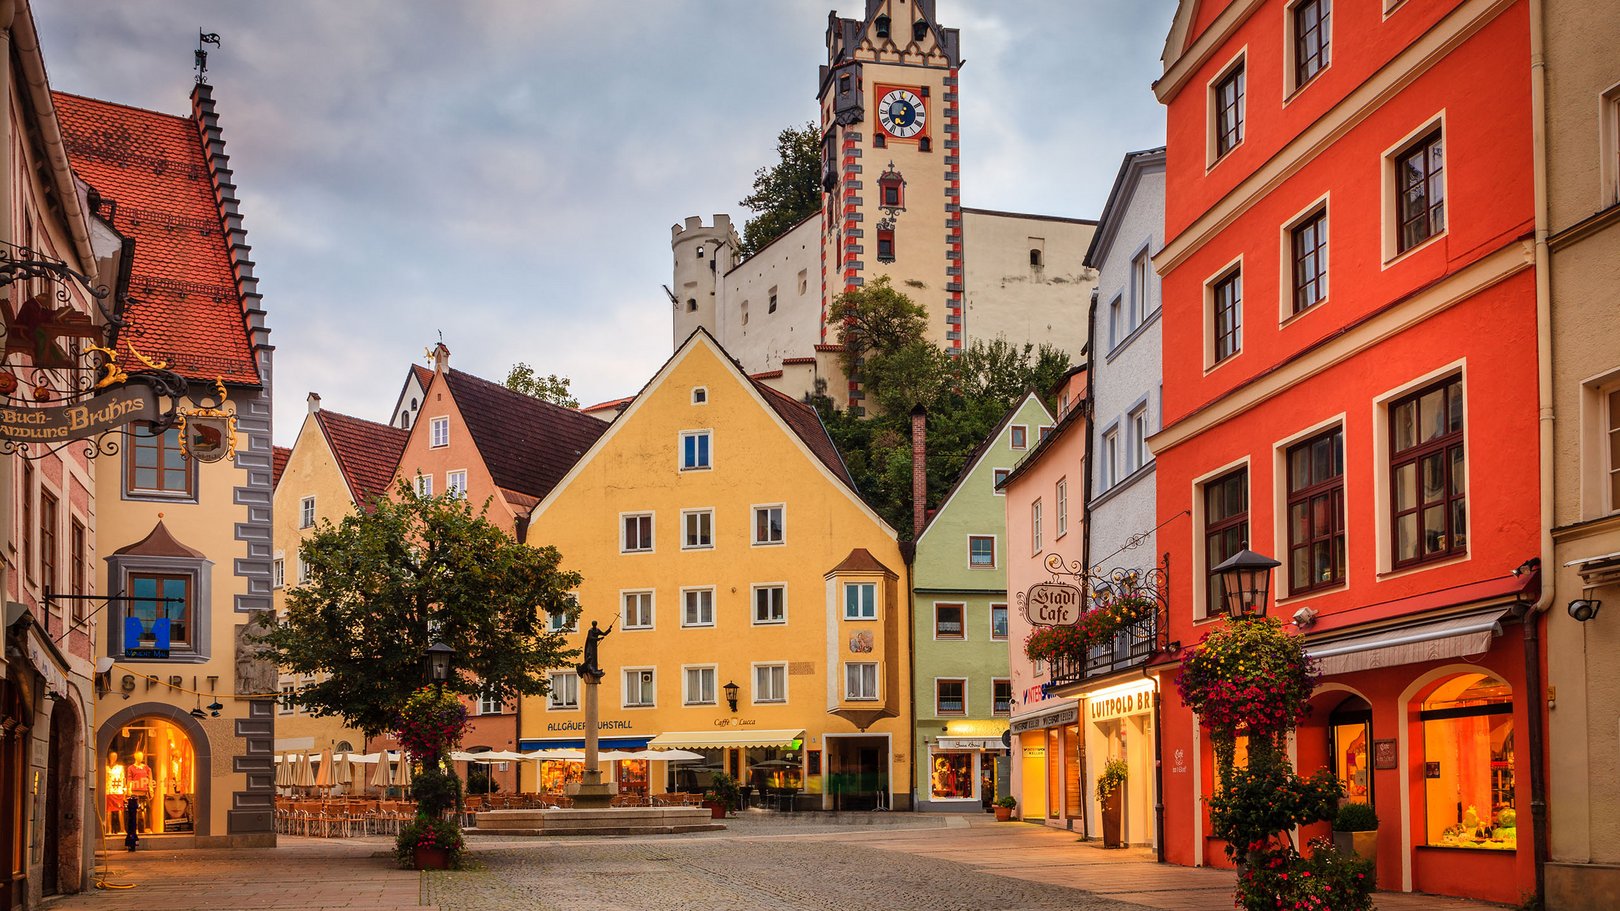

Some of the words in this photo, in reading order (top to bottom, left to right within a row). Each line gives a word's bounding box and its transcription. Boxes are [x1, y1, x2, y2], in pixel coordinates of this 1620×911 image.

[1, 408, 52, 424] Buch-
[63, 397, 145, 431] Bruhns
[0, 424, 68, 438] ANDLUNG
[1031, 587, 1076, 605] Stadt
[1039, 605, 1069, 624] Cafe
[122, 674, 219, 692] SPRIT
[1091, 695, 1133, 719] LUITPOLD
[597, 720, 632, 730] UHSTALL
[738, 718, 756, 726] Lucca
